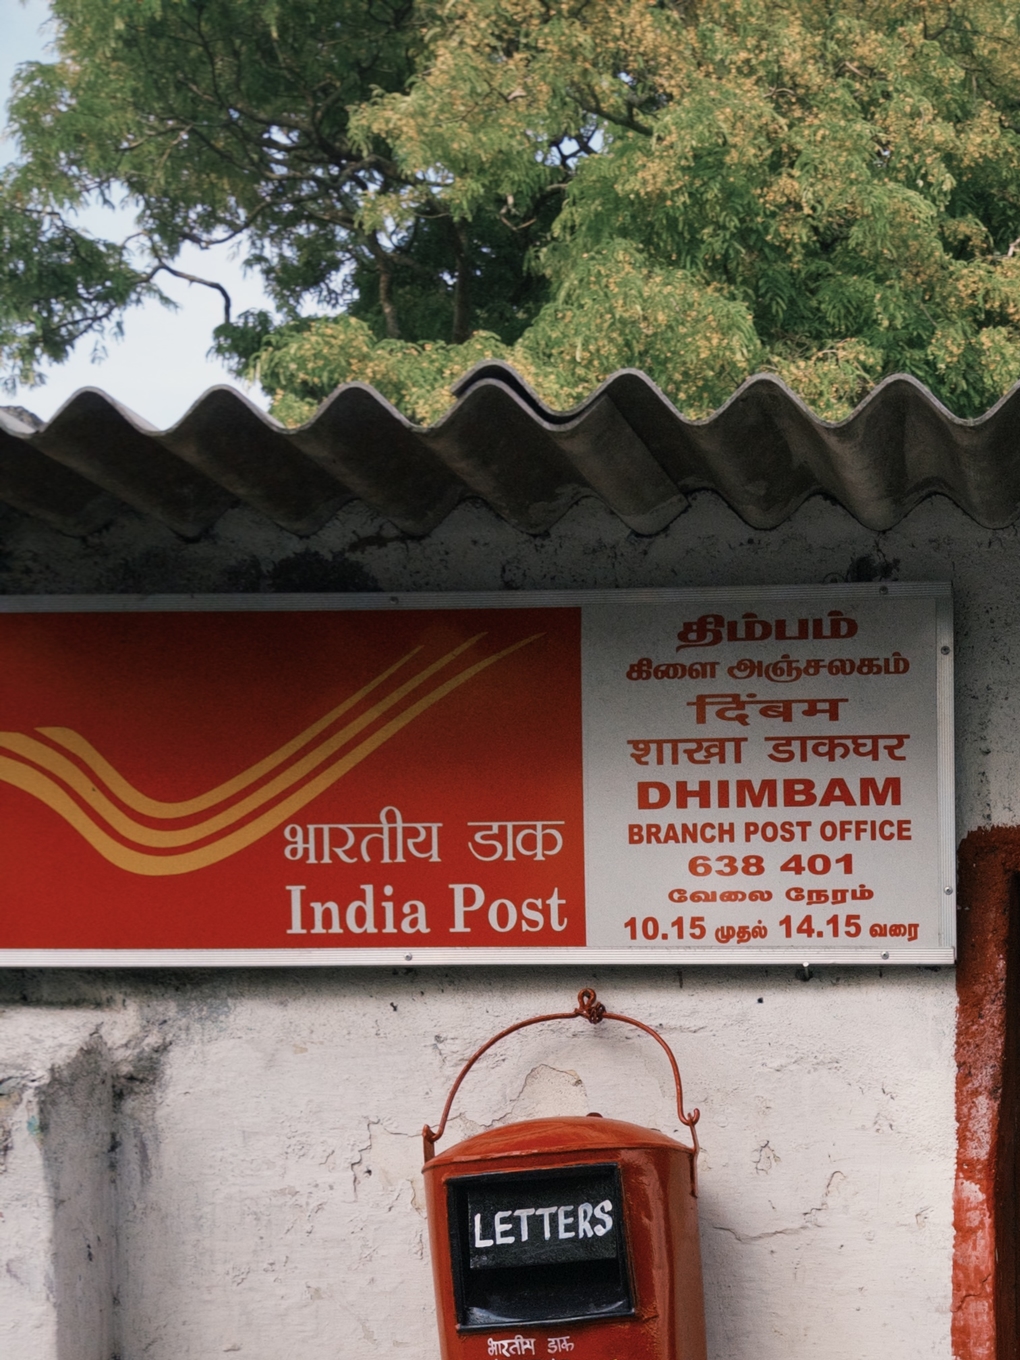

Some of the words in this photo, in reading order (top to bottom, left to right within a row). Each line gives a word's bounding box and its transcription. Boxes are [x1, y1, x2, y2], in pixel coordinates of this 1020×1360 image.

[676, 610, 858, 653] திம்பம்
[625, 657, 720, 682] கிளை
[727, 652, 910, 683] அஞ்சலகம்
[686, 693, 849, 727] दिंबम
[627, 736, 749, 766] शाखा
[765, 733, 910, 763] डाकघर
[637, 777, 901, 810] DHIMBAM
[283, 806, 443, 864] भारतीय
[467, 820, 565, 861] डाक
[628, 822, 735, 844] BRANCH
[745, 821, 812, 843] POST
[820, 819, 912, 841] OFFICE
[688, 854, 766, 877] 638
[780, 853, 854, 876] 401
[286, 885, 431, 935] India
[448, 884, 568, 935] Post
[667, 887, 773, 903] வேலை
[785, 884, 874, 905] நேரம்
[624, 916, 706, 940] 10.15
[715, 920, 768, 944] முதல்
[779, 915, 861, 939] 14.15
[869, 922, 919, 942] வரை
[474, 1199, 613, 1248] LETTERS
[487, 1334, 536, 1357] भारतीय
[547, 1336, 574, 1354] डाक
